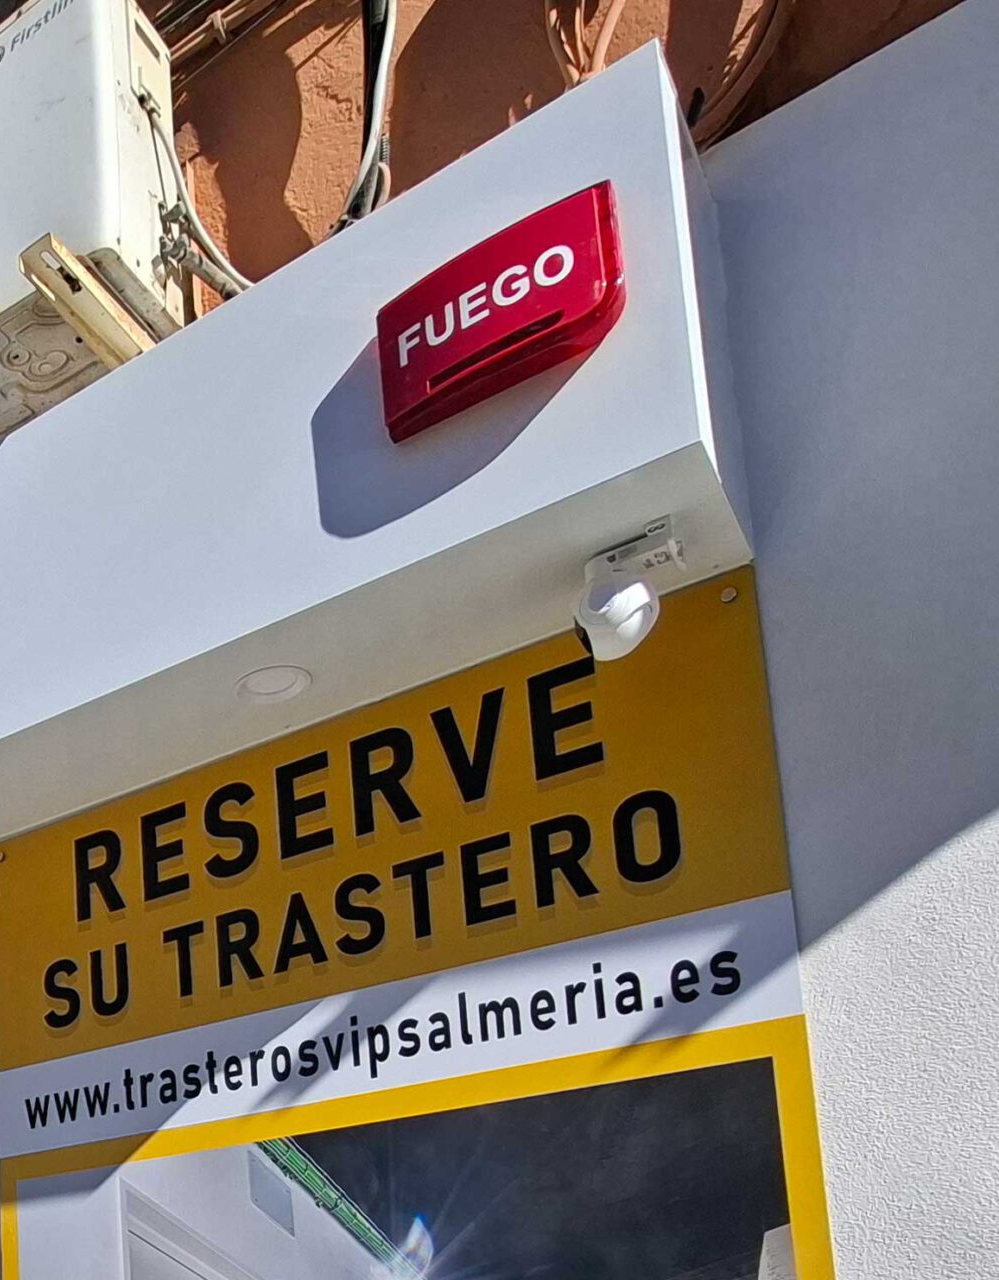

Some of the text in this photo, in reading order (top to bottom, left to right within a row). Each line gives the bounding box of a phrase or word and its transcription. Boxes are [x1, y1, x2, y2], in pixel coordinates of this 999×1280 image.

[398, 245, 574, 368] FUEGO
[74, 655, 604, 922] RESERVE
[44, 790, 682, 1029] SU TRASTERO
[25, 948, 742, 1130] www.trasterosvipsalmeria.es
